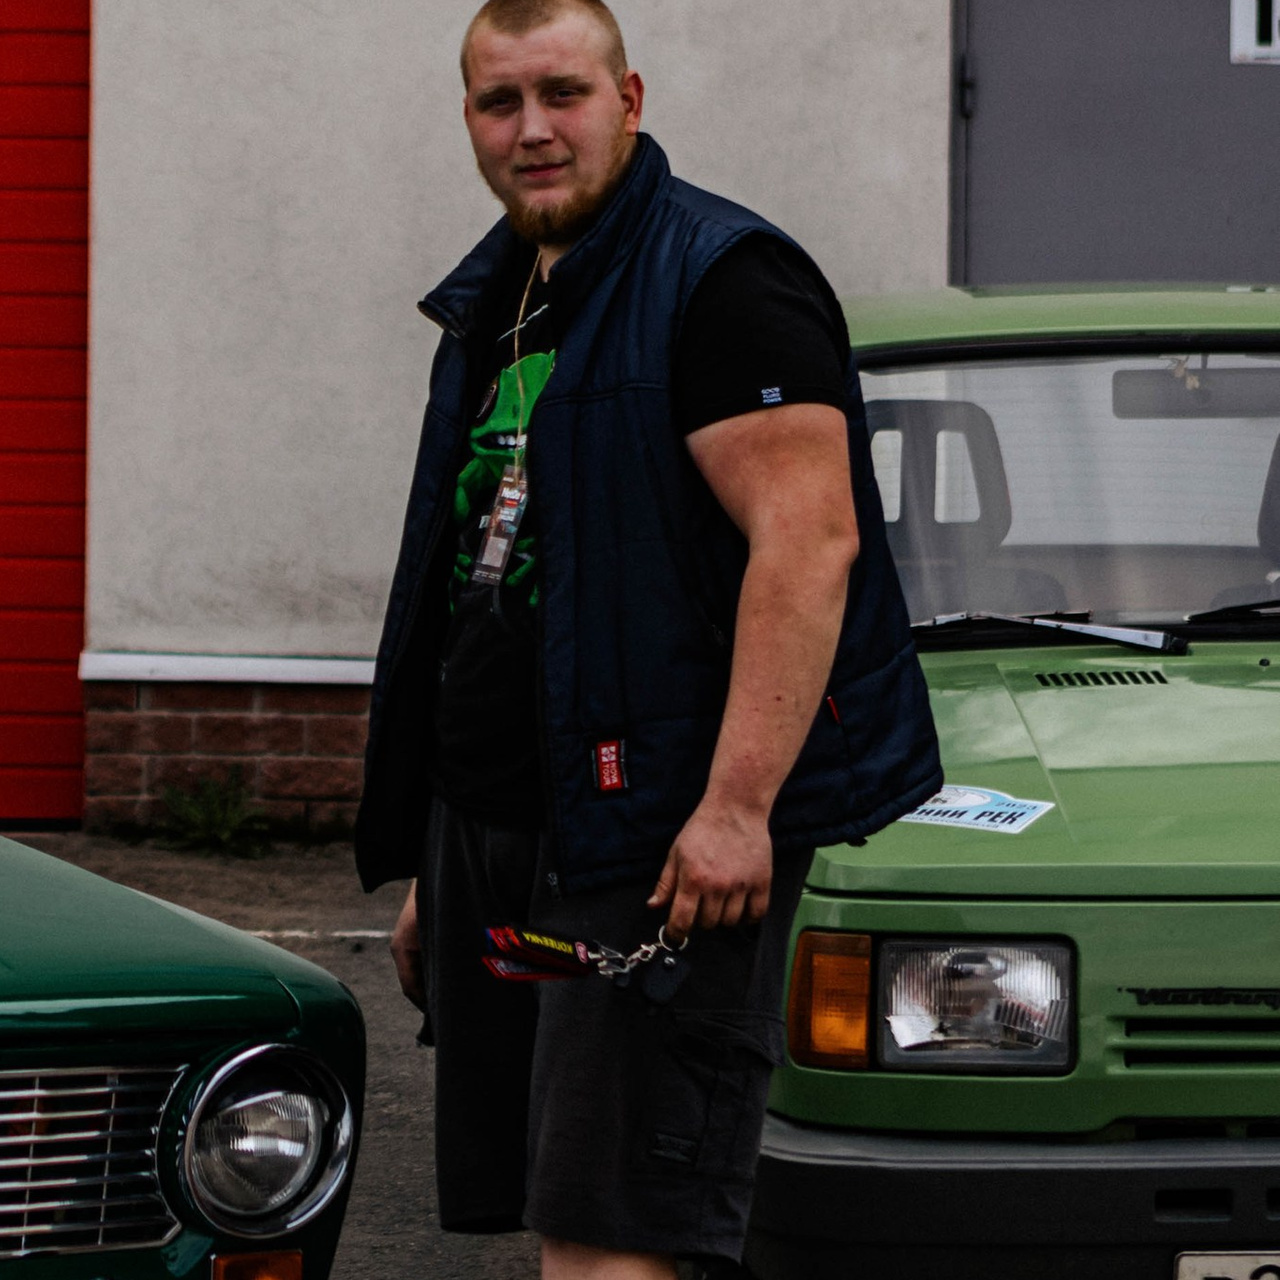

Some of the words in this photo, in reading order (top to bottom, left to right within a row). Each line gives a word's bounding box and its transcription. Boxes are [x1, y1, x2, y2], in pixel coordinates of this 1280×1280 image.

[602, 763, 611, 786] TOUR
[609, 762, 618, 784] NOVA
[972, 810, 1027, 825] РЕК
